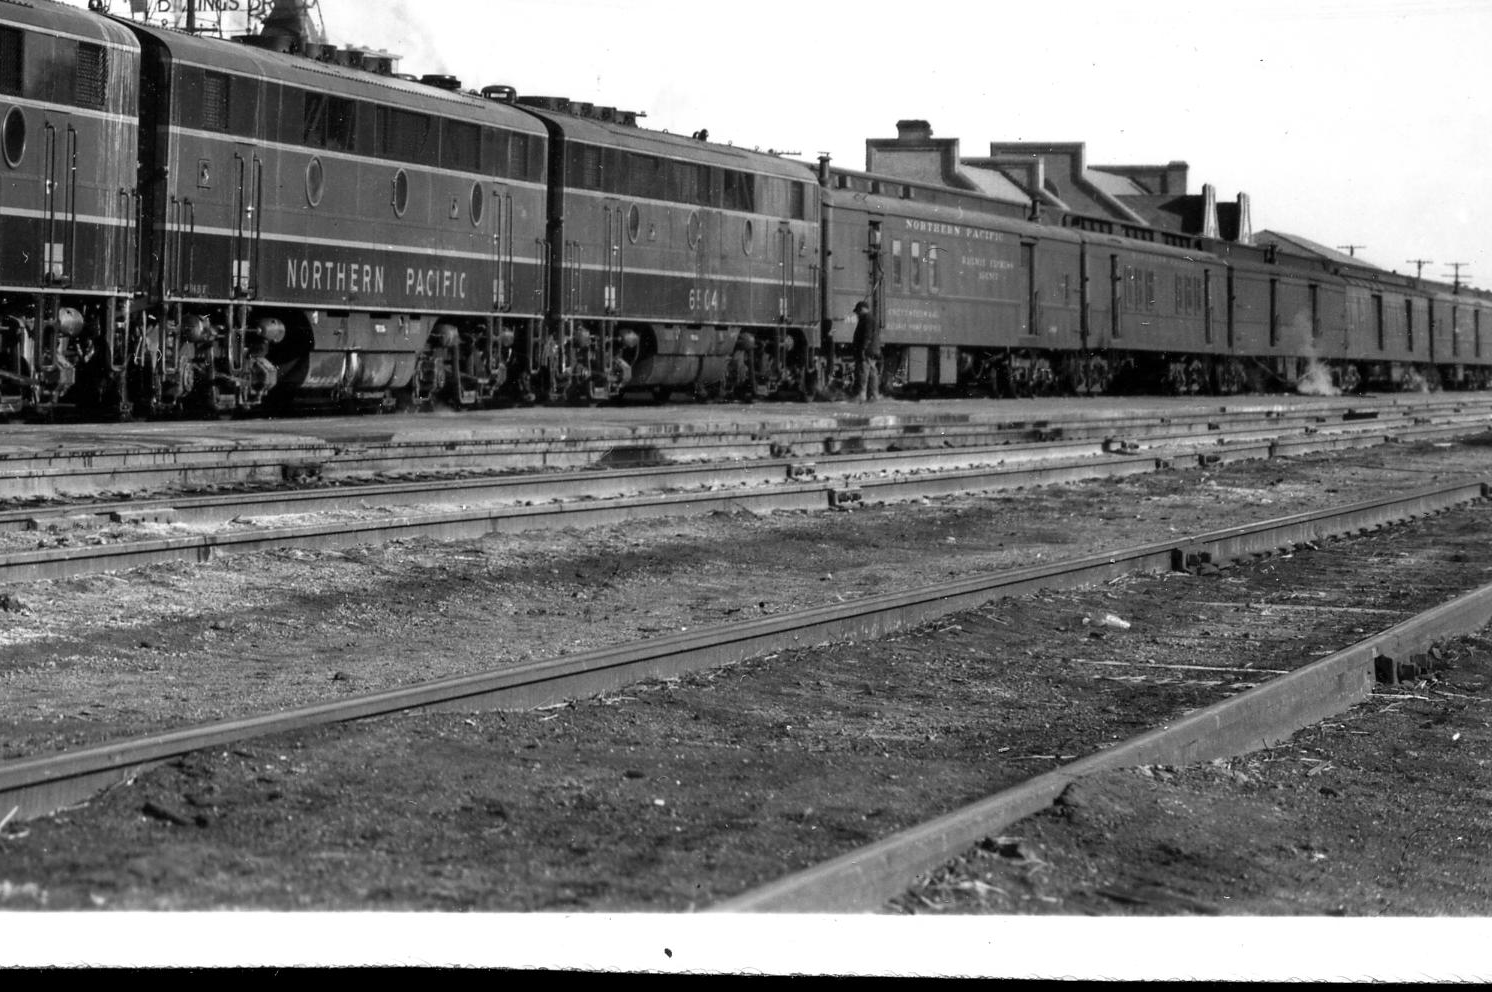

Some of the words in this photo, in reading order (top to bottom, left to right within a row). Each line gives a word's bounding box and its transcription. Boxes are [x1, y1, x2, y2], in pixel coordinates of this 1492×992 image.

[906, 218, 961, 236] NORTHERN
[287, 259, 384, 293] NORTHERN
[406, 267, 466, 298] PACIFIC
